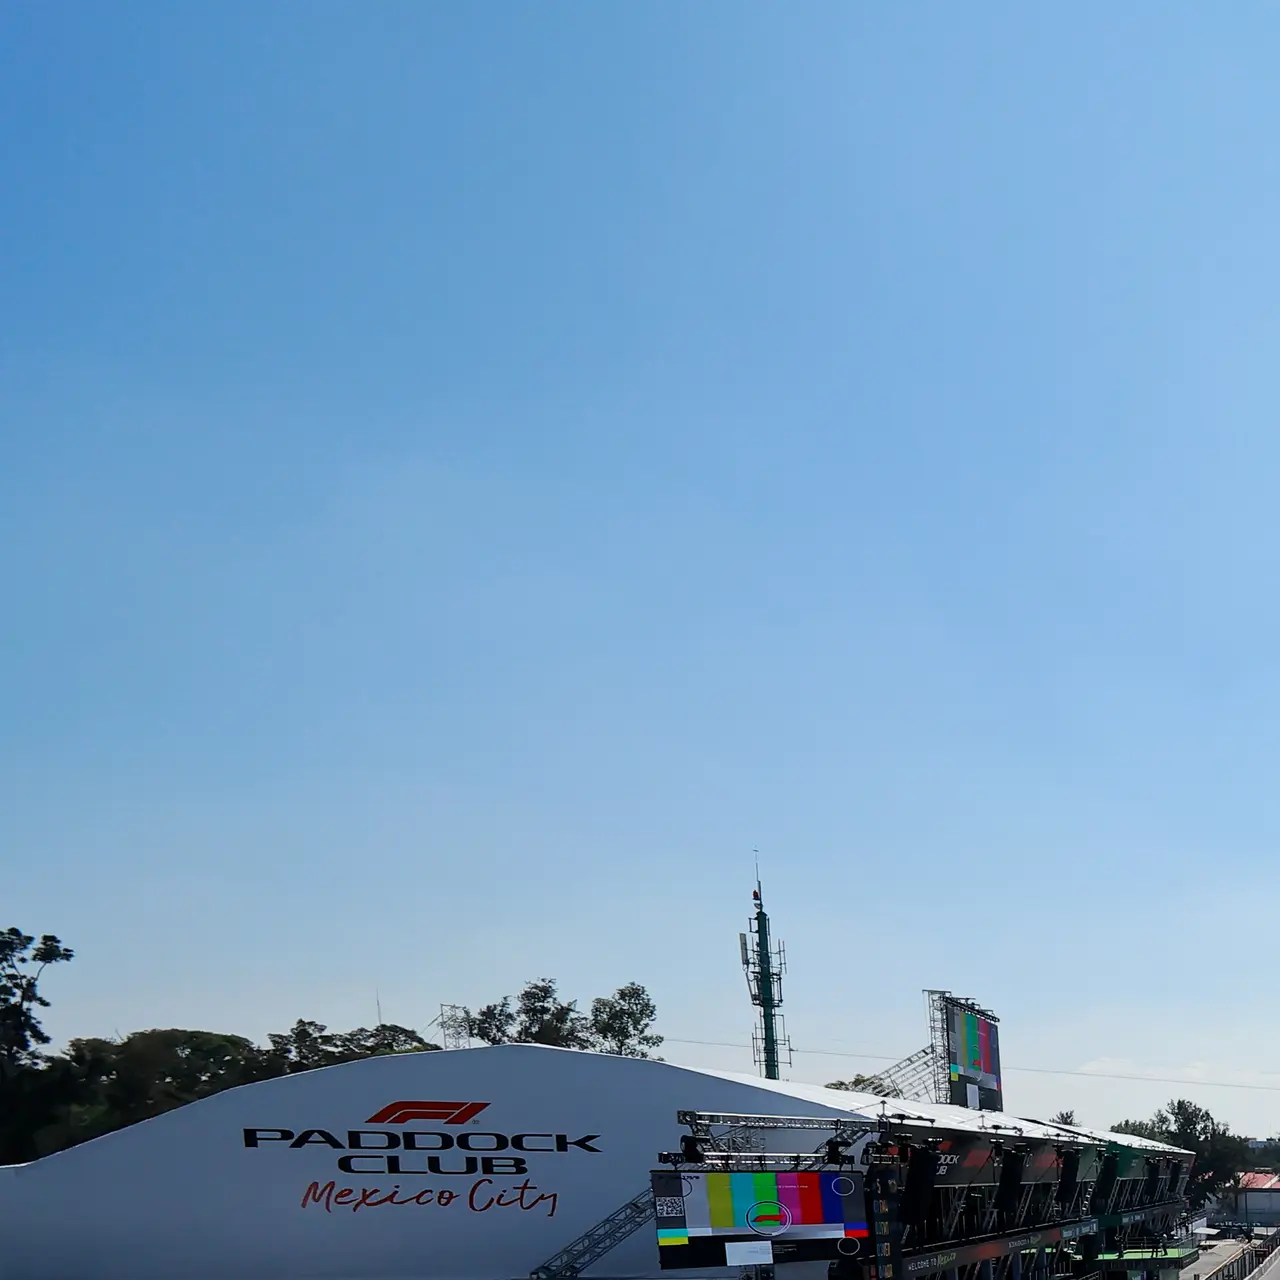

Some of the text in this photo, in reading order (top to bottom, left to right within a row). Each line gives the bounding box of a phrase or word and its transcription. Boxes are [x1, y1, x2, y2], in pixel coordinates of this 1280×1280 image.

[243, 1128, 604, 1153] PADDOCK
[338, 1155, 529, 1175] CLUB
[302, 1177, 558, 1217] Mexico City
